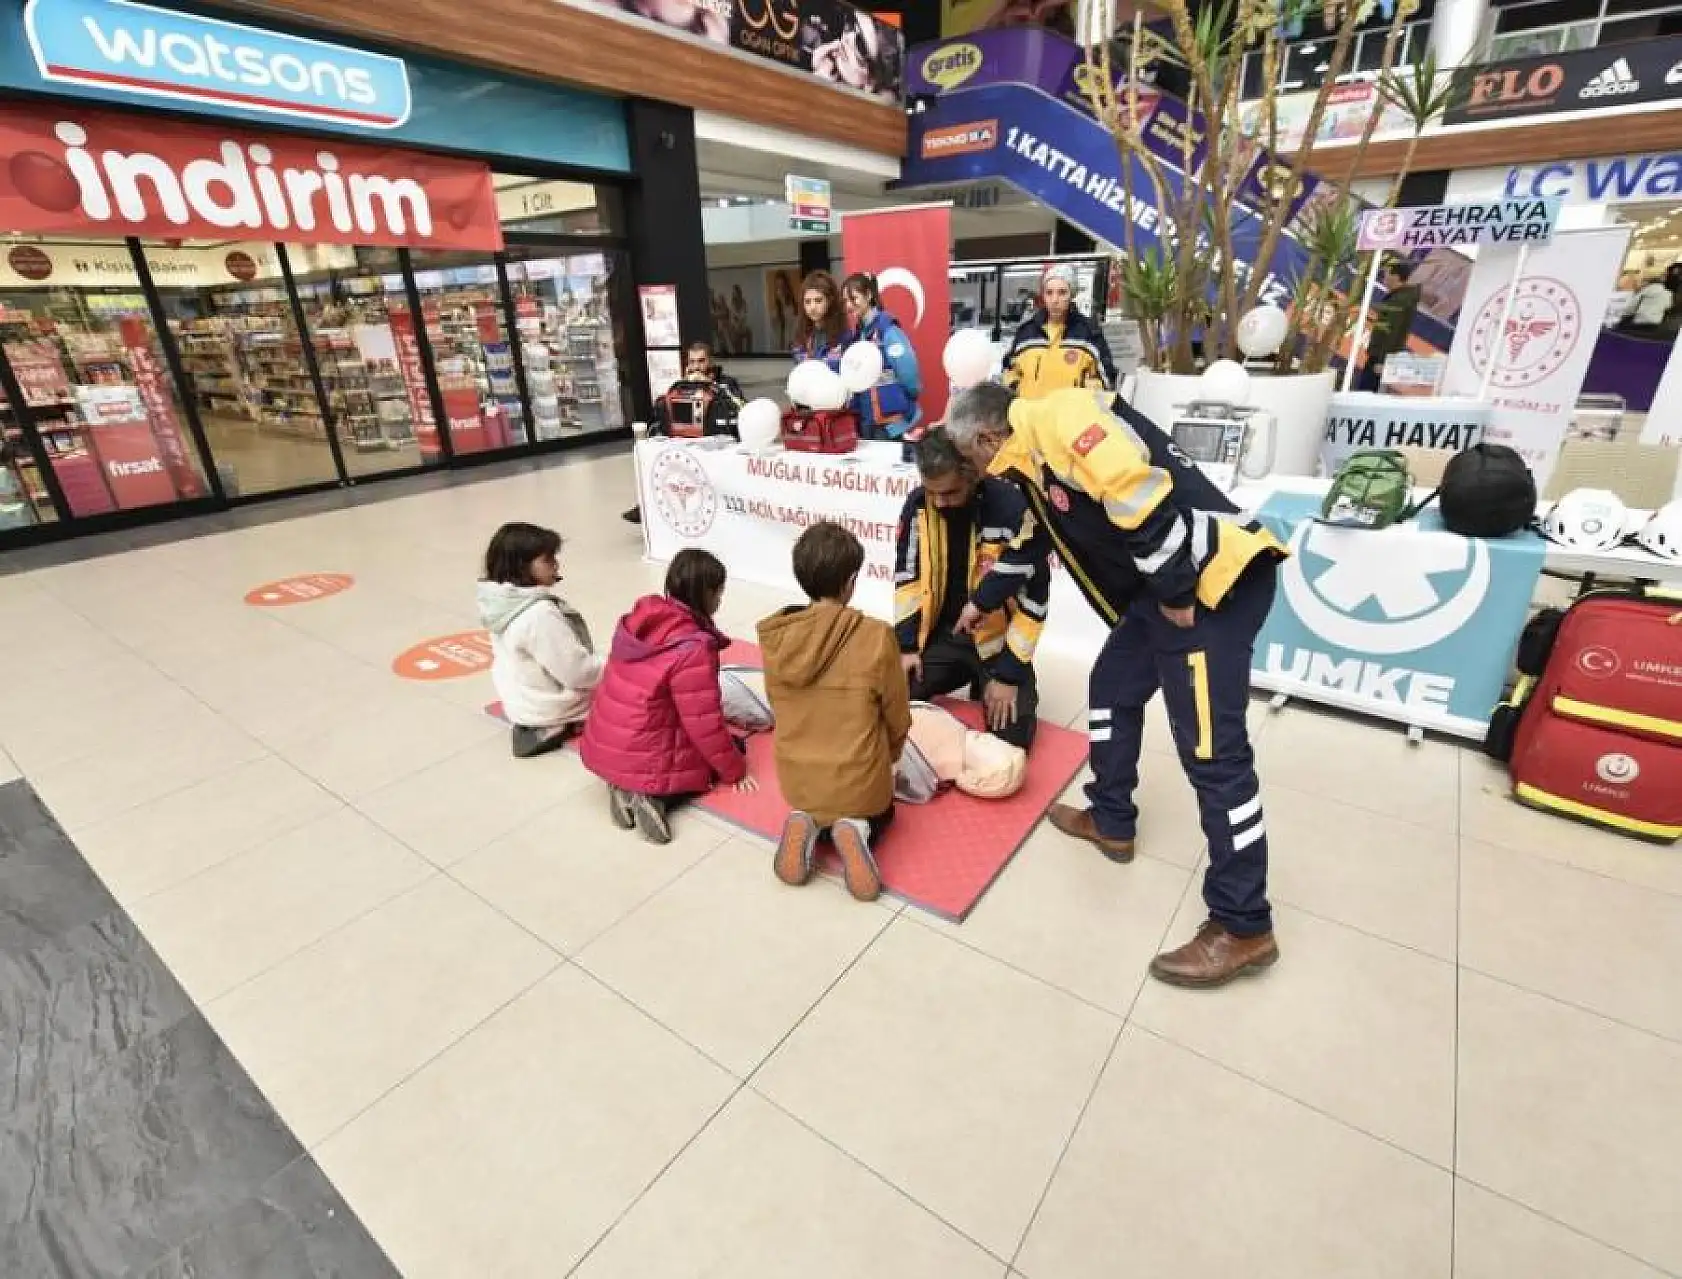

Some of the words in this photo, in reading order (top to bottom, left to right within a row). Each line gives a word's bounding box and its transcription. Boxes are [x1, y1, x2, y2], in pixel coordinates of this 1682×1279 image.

[84, 15, 377, 105] watsons
[928, 46, 976, 81] gratis
[1469, 64, 1564, 106] FLO
[1578, 80, 1641, 100] adidas
[54, 121, 432, 236] indirim
[1411, 201, 1547, 228] ZEHRA'YA
[1402, 225, 1484, 247] HAYAT
[1491, 221, 1551, 243] VER!
[1385, 420, 1478, 453] HAYAT
[746, 456, 800, 483] MUĞLA
[821, 466, 880, 494] SAĞLIK
[1266, 642, 1456, 715] UMKE
